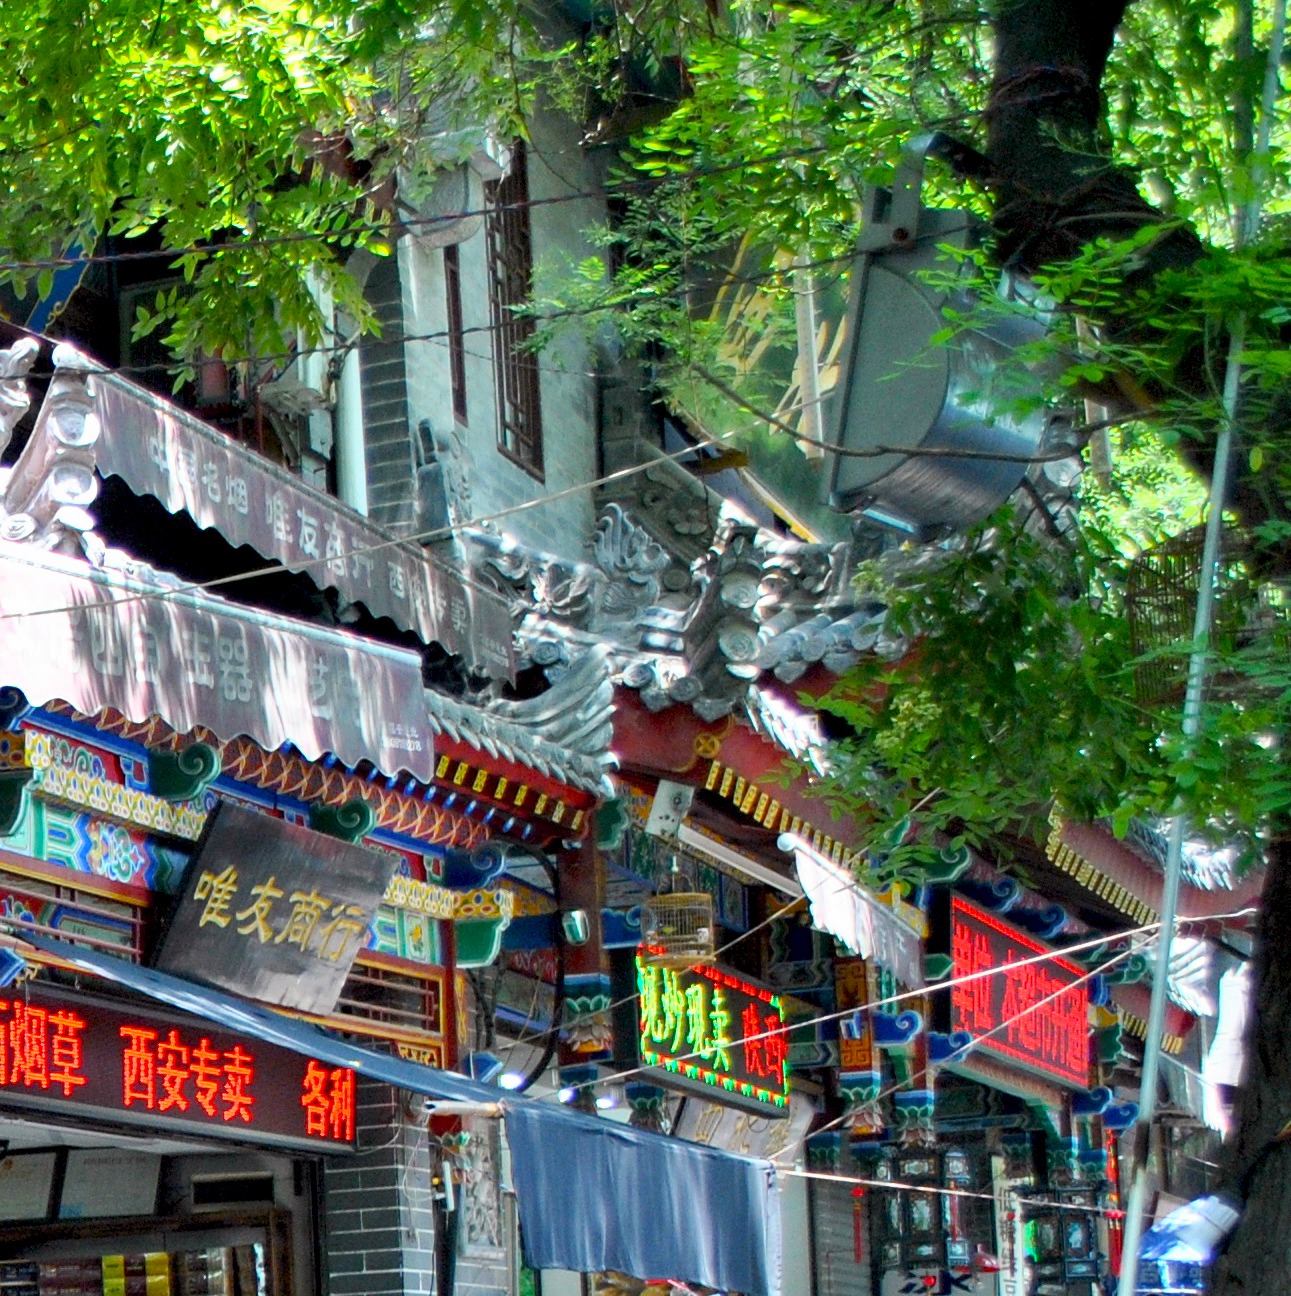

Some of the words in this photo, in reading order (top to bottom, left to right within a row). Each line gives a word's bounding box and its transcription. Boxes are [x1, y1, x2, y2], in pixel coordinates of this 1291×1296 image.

[194, 866, 368, 962] 唯友商行
[120, 1023, 256, 1123] 西安专卖
